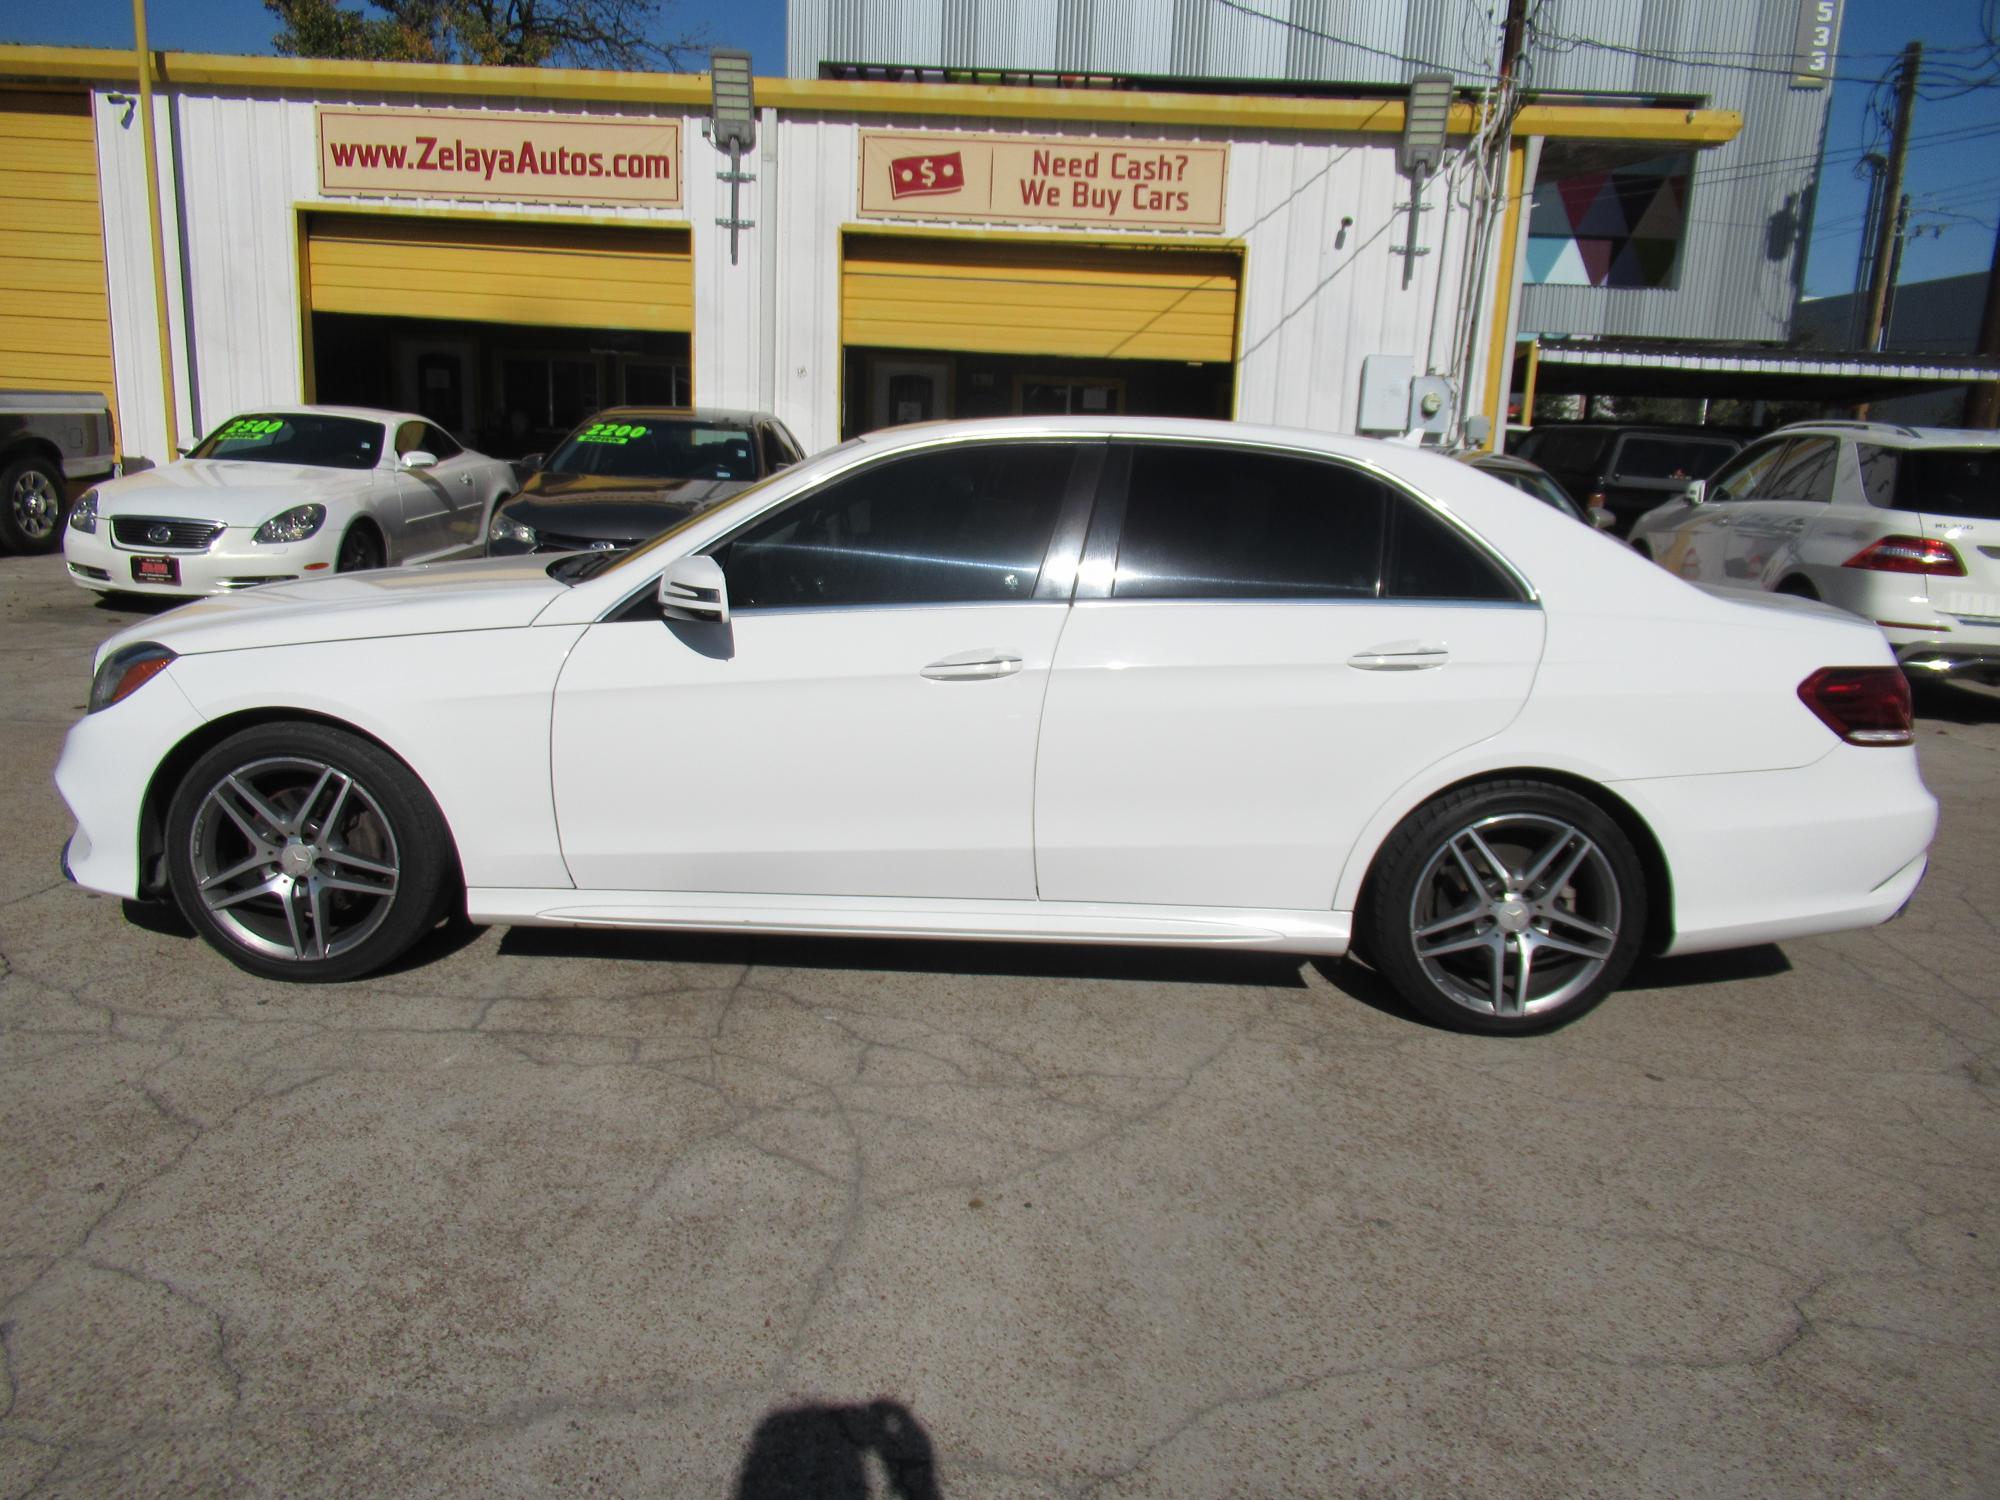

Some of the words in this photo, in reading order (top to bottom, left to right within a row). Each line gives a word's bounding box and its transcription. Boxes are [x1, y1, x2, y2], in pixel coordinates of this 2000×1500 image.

[330, 136, 670, 181] www.ZelayaAutos.com
[1032, 150, 1099, 179] Need
[1110, 153, 1189, 182] Cash?
[1020, 178, 1061, 208] We
[1072, 181, 1122, 216] Buy
[1132, 184, 1190, 212] Cars
[224, 420, 283, 434] 2500
[585, 423, 647, 438] 2200
